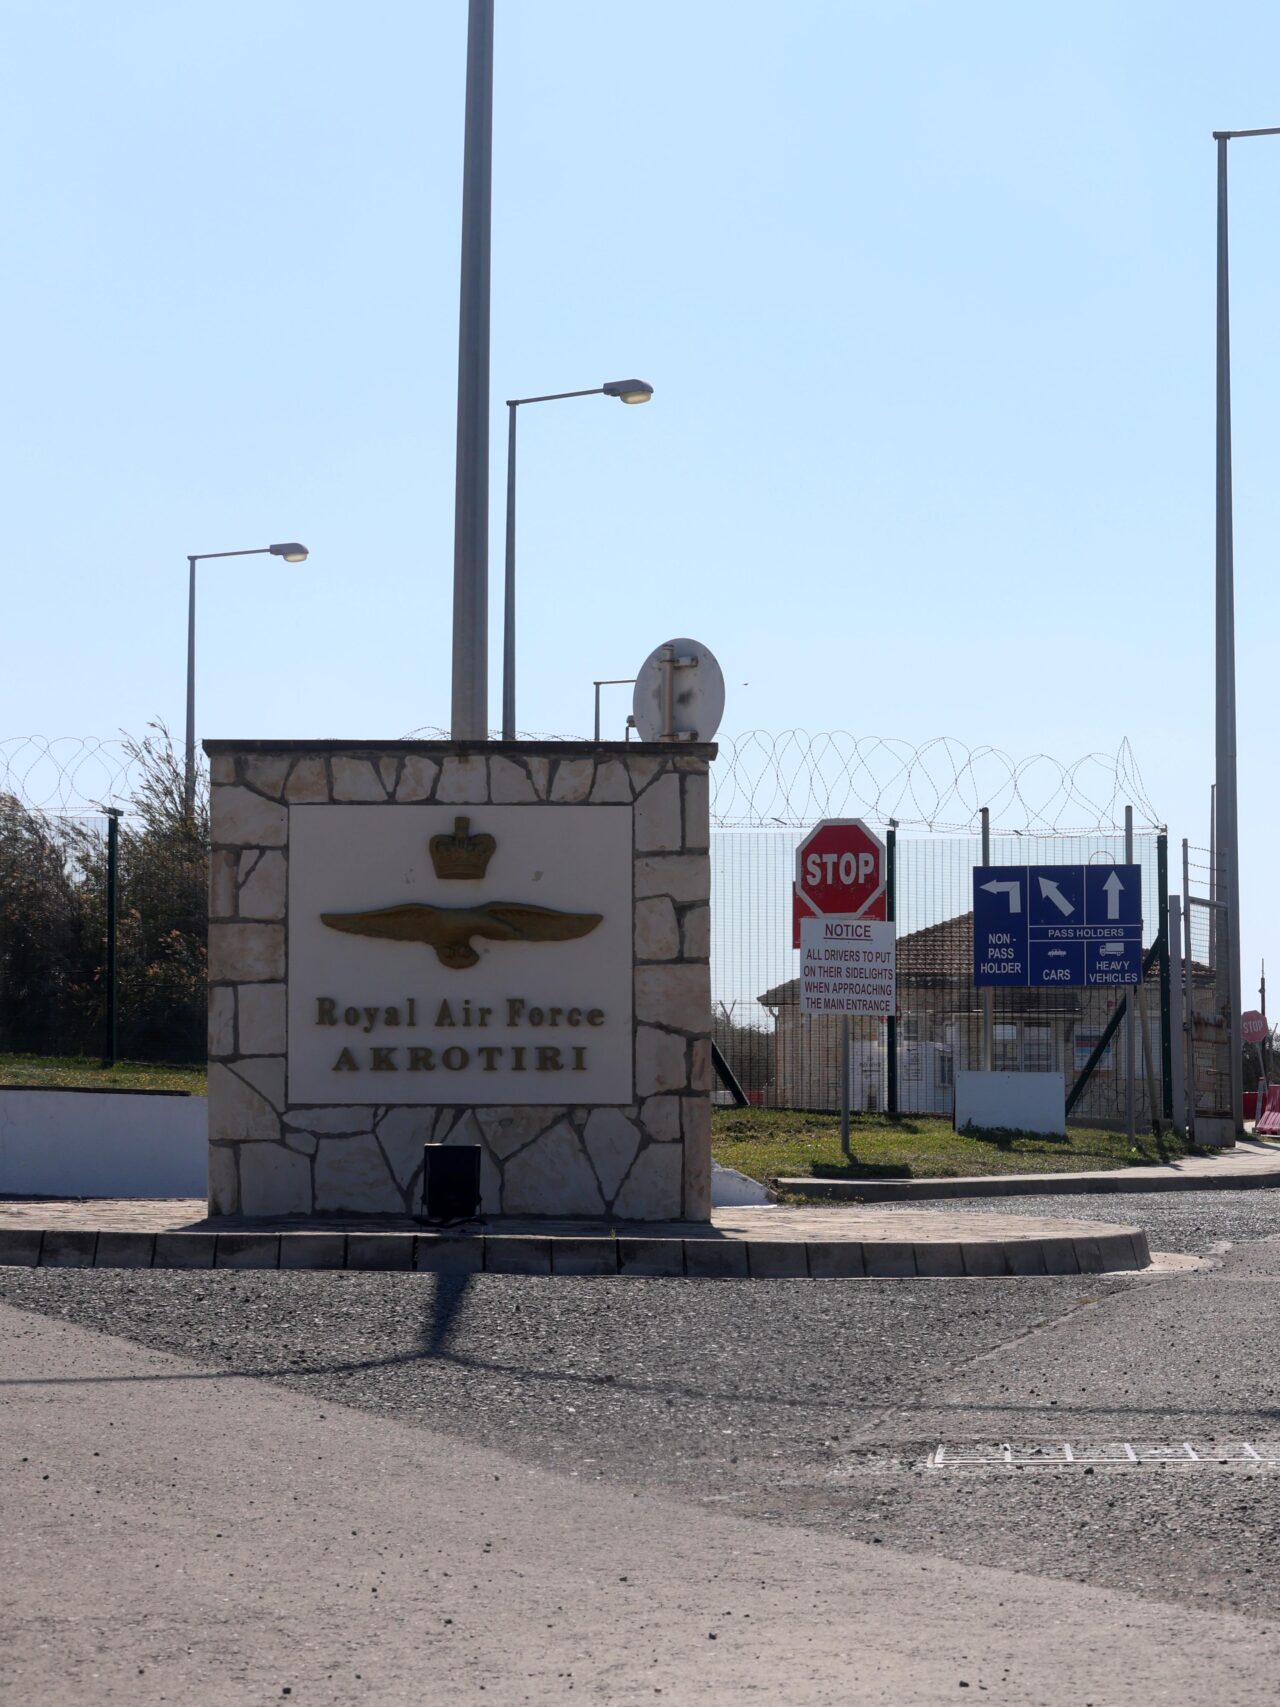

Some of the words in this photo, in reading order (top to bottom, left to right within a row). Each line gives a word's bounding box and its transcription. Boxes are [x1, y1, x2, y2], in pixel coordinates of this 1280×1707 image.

[806, 852, 875, 886] STOP
[825, 924, 871, 937] NOTICE
[1048, 929, 1074, 938] PASS
[1077, 929, 1124, 937] HOLDERS
[989, 934, 1010, 944] NON
[807, 949, 822, 960] ALL
[825, 949, 860, 961] DRIVERS
[863, 951, 873, 962] TO
[876, 952, 891, 963] PUT
[988, 948, 1014, 959] PASS
[981, 963, 1021, 973] HOLDER
[1096, 961, 1130, 970] HEAVY
[804, 966, 815, 976] ON
[818, 966, 842, 978] THEIR
[846, 967, 893, 979] SIDELIGHTS
[1043, 969, 1070, 980] CARS
[1089, 973, 1138, 983] VEHICLES
[805, 982, 829, 993] WHEN
[832, 983, 892, 995] APPROACHING
[806, 997, 821, 1009] THE
[824, 998, 844, 1009] MAIN
[847, 999, 890, 1011] ENTRANCE
[315, 997, 417, 1033] Royal
[435, 998, 492, 1027] Air
[506, 998, 606, 1027] Force
[1243, 1020, 1263, 1033] STOP
[332, 1046, 588, 1071] AKROTIRI
